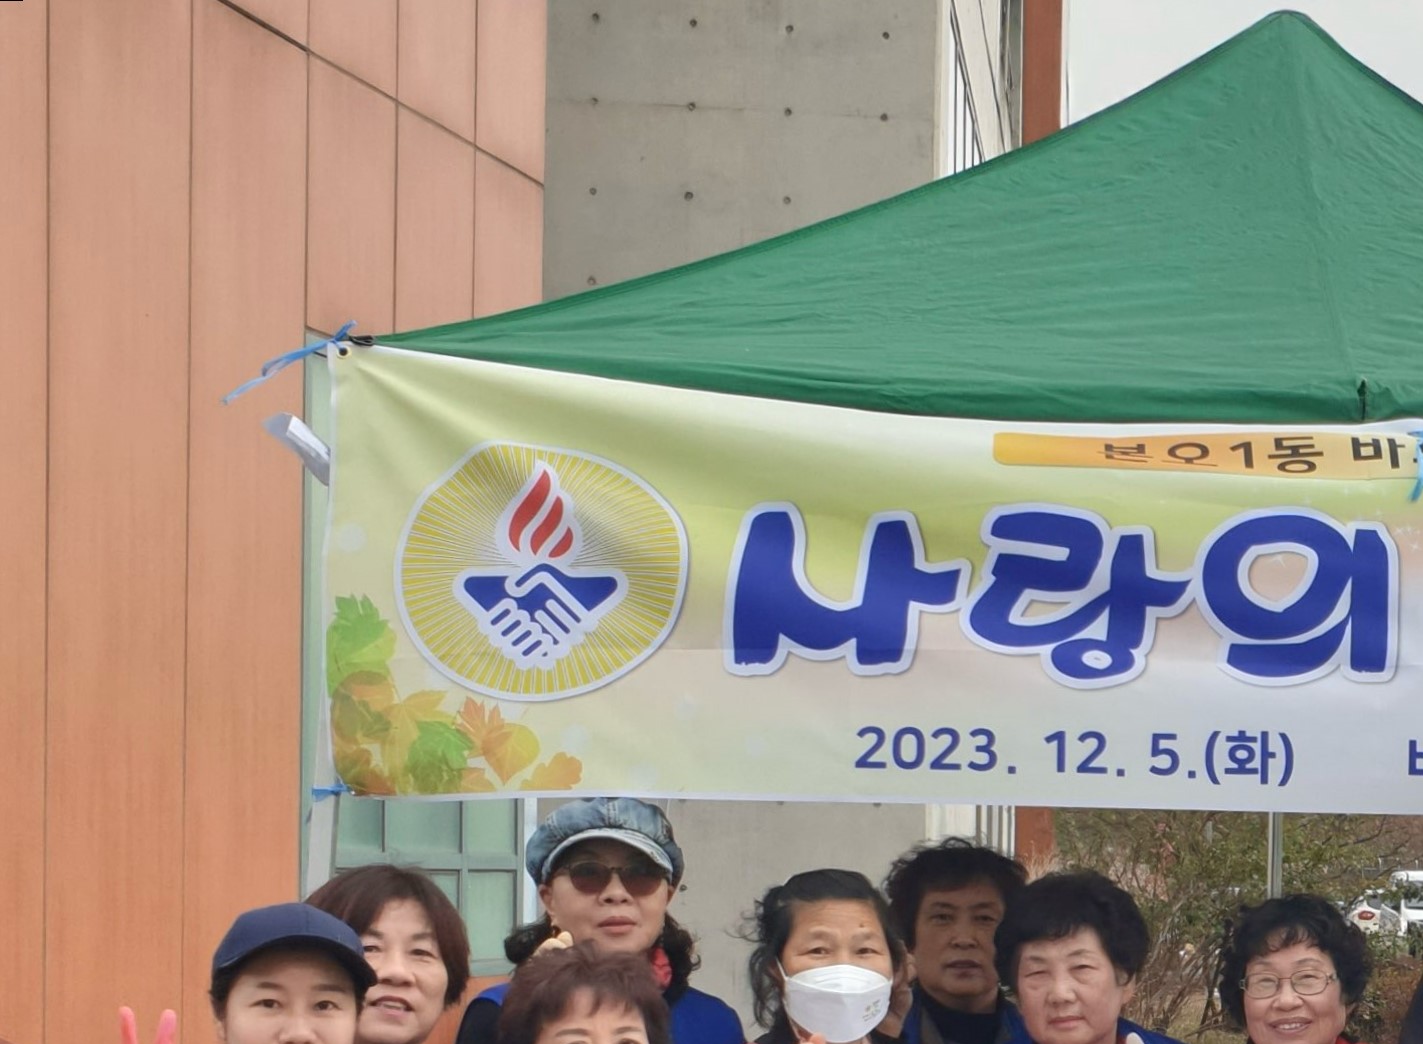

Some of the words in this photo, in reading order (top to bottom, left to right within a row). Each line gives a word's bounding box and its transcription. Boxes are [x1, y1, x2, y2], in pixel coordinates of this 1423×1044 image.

[1098, 436, 1323, 474] 본오1동
[731, 509, 1390, 681] 사랑의
[854, 726, 1017, 774] 2023.
[1044, 730, 1126, 777] 12.
